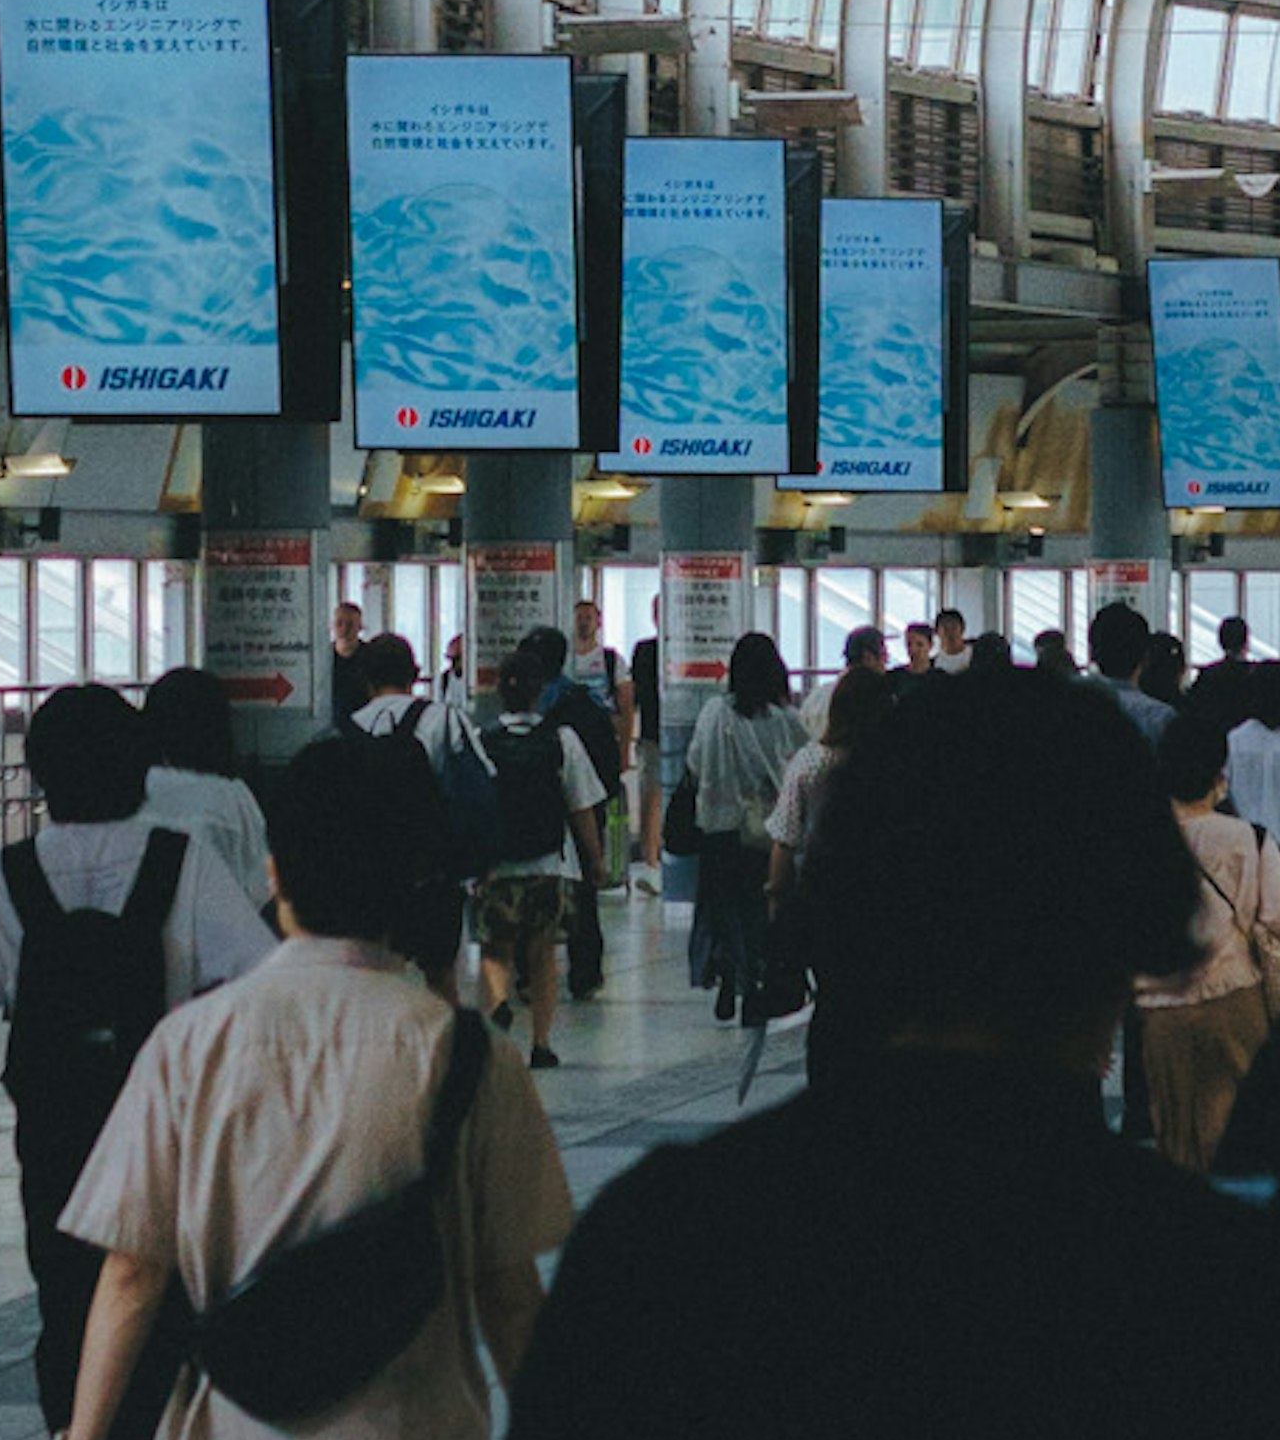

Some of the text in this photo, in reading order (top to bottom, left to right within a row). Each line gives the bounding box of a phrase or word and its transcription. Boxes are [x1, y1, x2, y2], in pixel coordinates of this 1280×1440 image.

[98, 366, 230, 392] ISHIGAKI
[428, 408, 537, 429] ISHIGAKI
[658, 439, 753, 458] ISHIGAKI
[830, 460, 912, 477] ISHIGAKI
